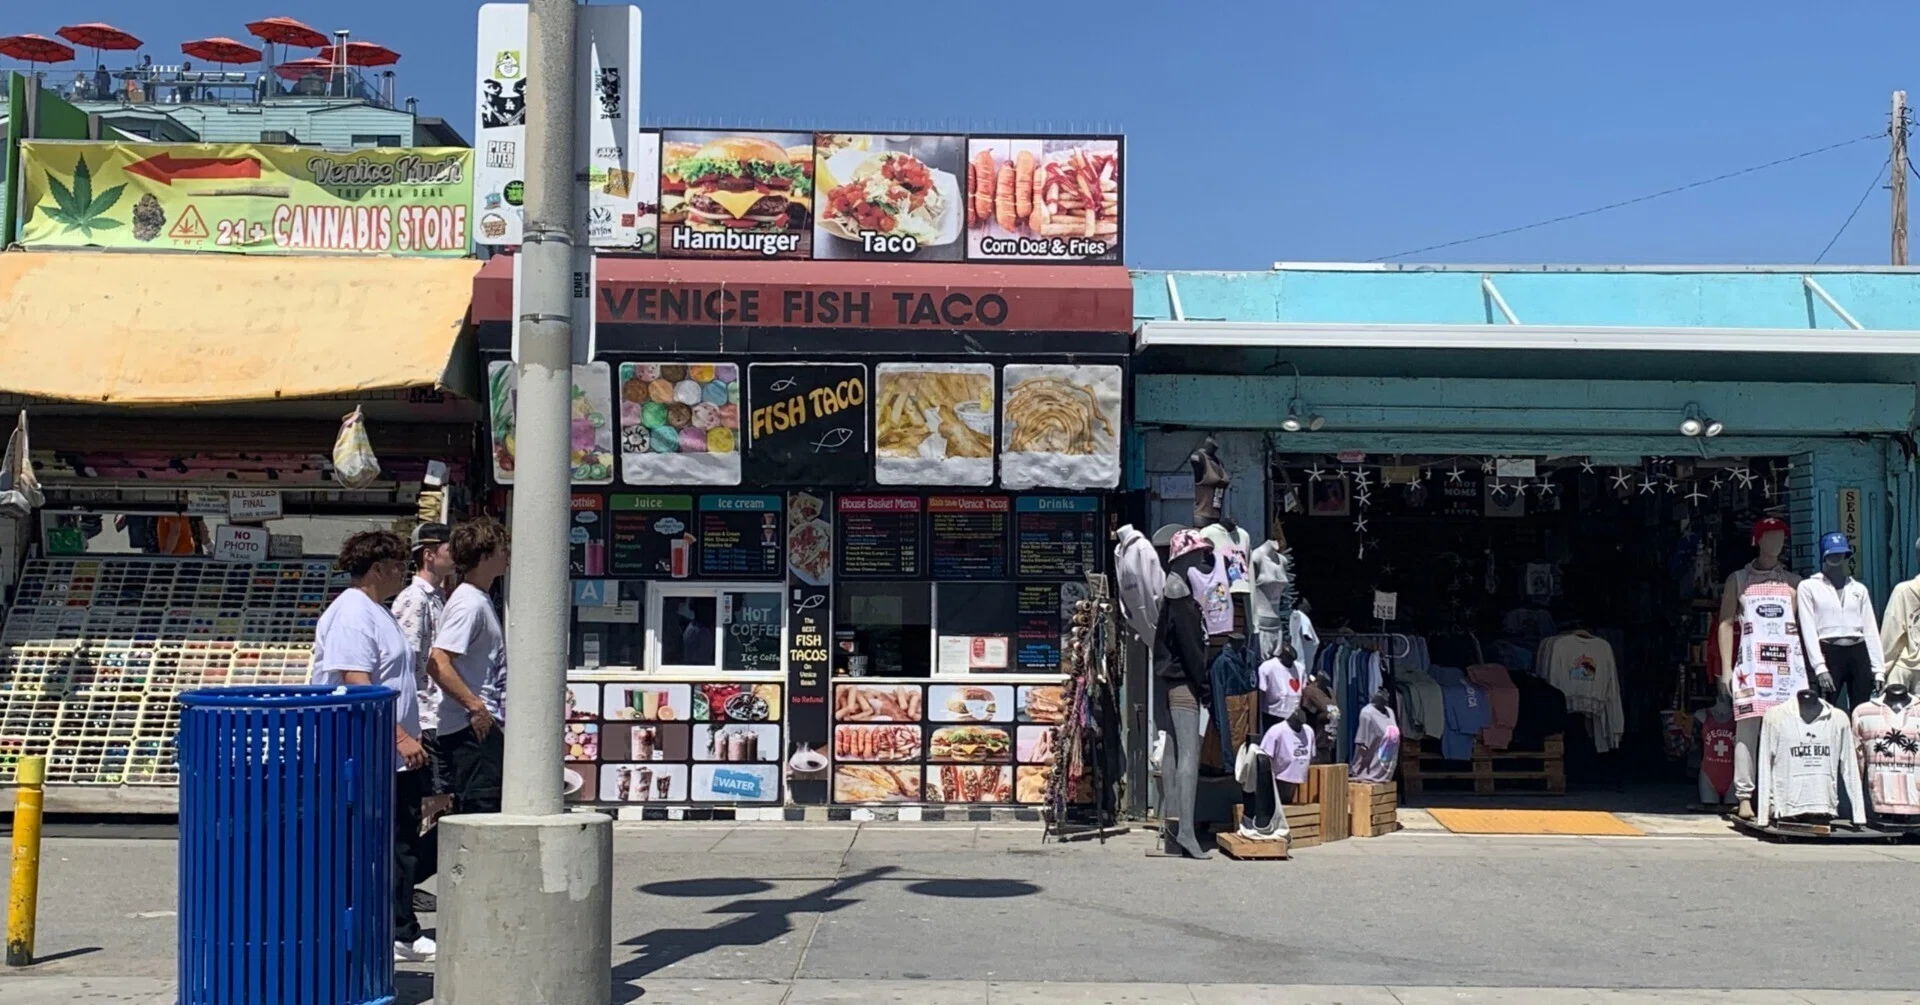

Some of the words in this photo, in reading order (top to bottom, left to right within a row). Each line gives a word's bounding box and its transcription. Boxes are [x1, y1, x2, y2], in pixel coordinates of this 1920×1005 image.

[488, 140, 515, 153] PIER
[487, 152, 514, 164] BITER
[308, 156, 394, 185] Venice
[397, 155, 463, 186] Kush
[337, 188, 360, 198] THE
[371, 188, 402, 198] REAL
[413, 188, 444, 197] DEAL
[215, 218, 267, 247] 21+
[272, 203, 393, 251] CANNABIS
[397, 204, 467, 251] STORE
[673, 226, 801, 256] Hamburger
[860, 229, 917, 254] Taco
[981, 237, 1018, 255] Corn
[1019, 237, 1049, 255] Dog
[1050, 237, 1067, 254] &
[1069, 237, 1107, 255] Fries
[601, 287, 759, 322] VENICE
[784, 290, 869, 324] FISH
[893, 291, 1009, 326] TACO
[752, 395, 806, 440] FISH
[809, 377, 864, 418] TACO
[233, 490, 247, 498] ALL
[251, 489, 277, 498] SALES
[243, 500, 266, 508] FINAL
[634, 497, 663, 508] Juice
[718, 498, 733, 508] Ice
[734, 499, 765, 508] cream
[841, 498, 866, 508] House
[867, 498, 893, 508] Basket
[895, 498, 917, 508] Menu
[958, 498, 985, 509] Venice
[985, 498, 1008, 509] Tacos
[1038, 498, 1075, 509] Drinks
[234, 531, 251, 541] NO
[223, 540, 259, 552] PHOTO
[579, 580, 599, 600] A
[742, 606, 772, 622] HOT
[730, 624, 781, 637] COFFEE
[795, 634, 822, 647] FISH
[790, 649, 828, 661] TACOS
[719, 777, 755, 791] WATER
